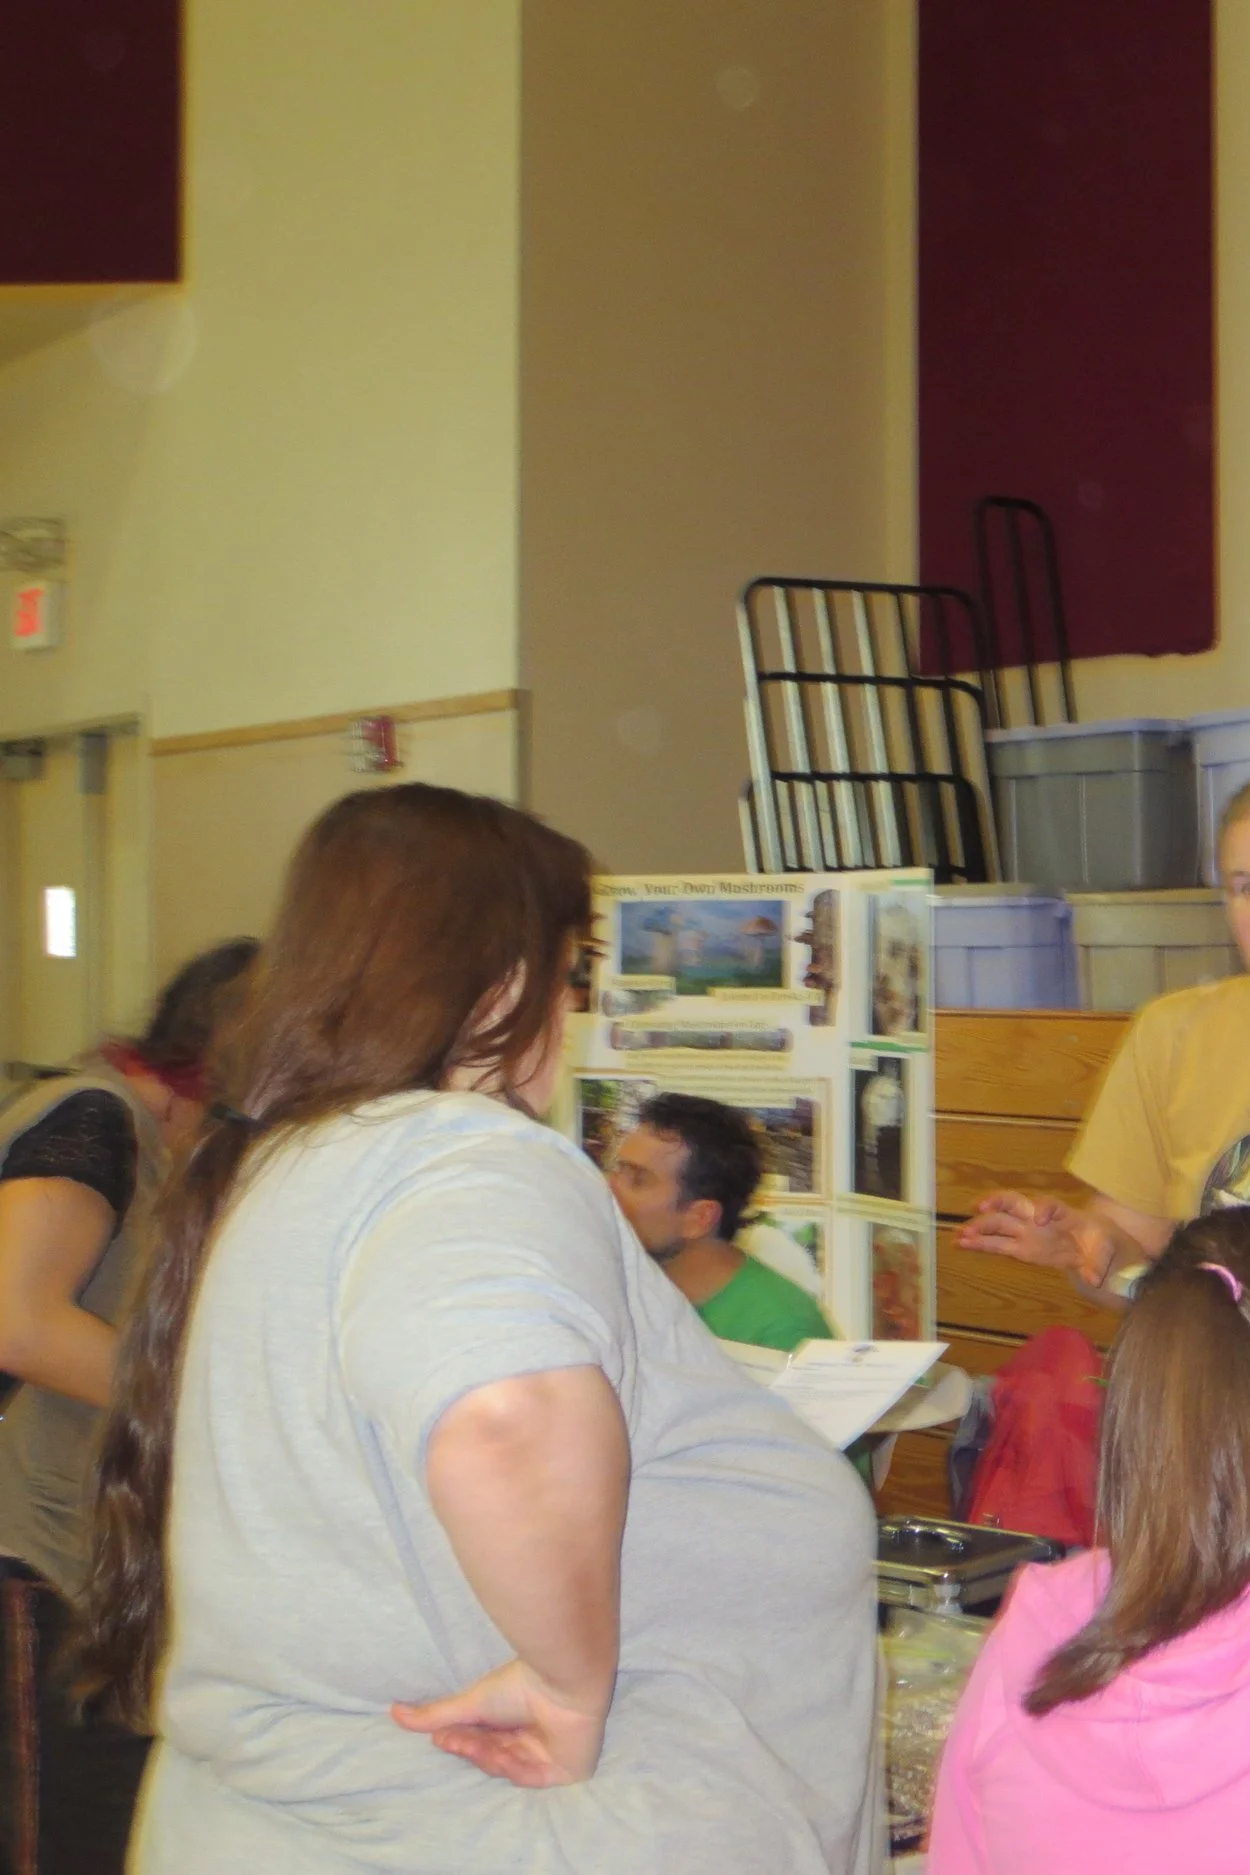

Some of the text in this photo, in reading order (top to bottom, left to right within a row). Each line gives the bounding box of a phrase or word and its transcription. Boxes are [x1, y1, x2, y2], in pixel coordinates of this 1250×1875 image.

[644, 883, 678, 896] Your
[683, 881, 717, 894] Own
[720, 881, 805, 894] Mushrooms
